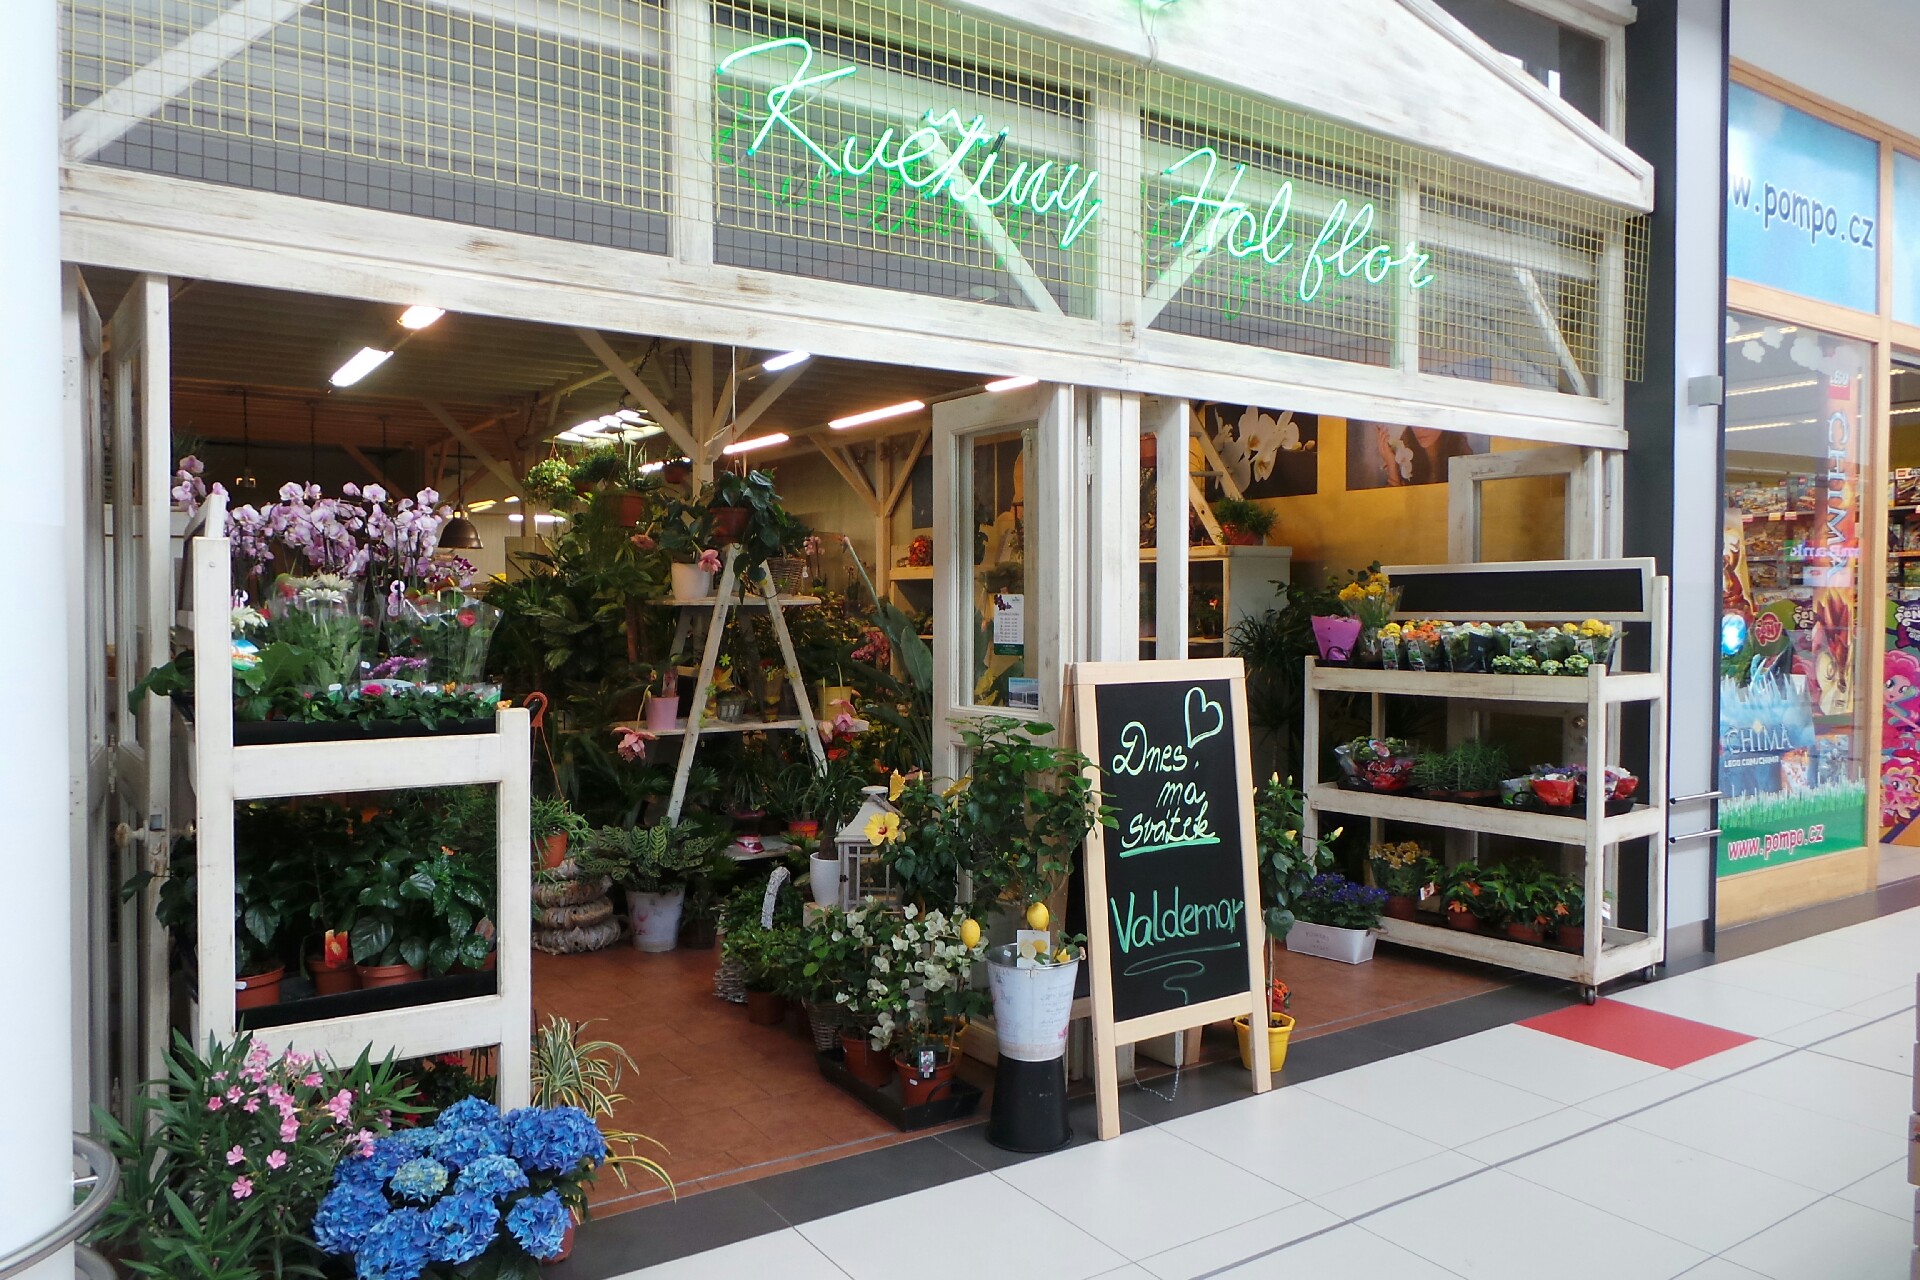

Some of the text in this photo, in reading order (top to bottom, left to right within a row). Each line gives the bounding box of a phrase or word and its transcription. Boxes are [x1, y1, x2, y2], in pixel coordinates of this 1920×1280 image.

[716, 37, 1103, 249] Květiny
[1728, 174, 1874, 250] w.pompo.cz
[1725, 726, 1793, 755] CHIMA
[1728, 825, 1824, 860] www.pompo.cz
[1109, 885, 1244, 954] Valdemar
